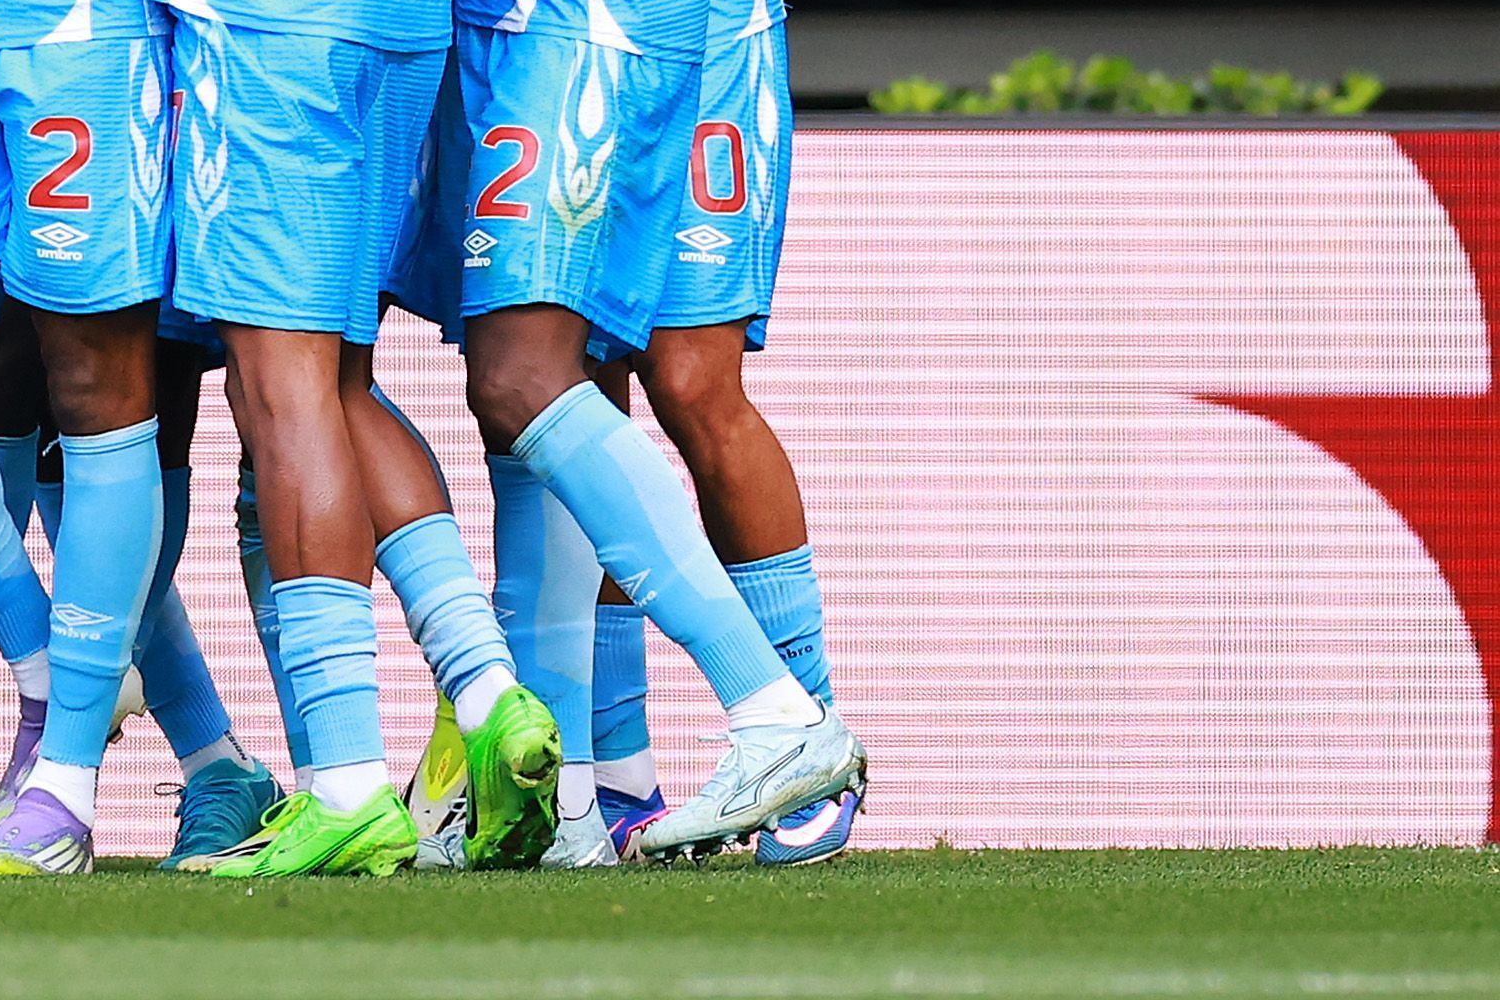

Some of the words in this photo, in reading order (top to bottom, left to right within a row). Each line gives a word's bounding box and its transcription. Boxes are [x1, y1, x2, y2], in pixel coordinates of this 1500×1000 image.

[27, 115, 93, 212] 2
[36, 247, 84, 261] umbro
[678, 251, 727, 266] umbro
